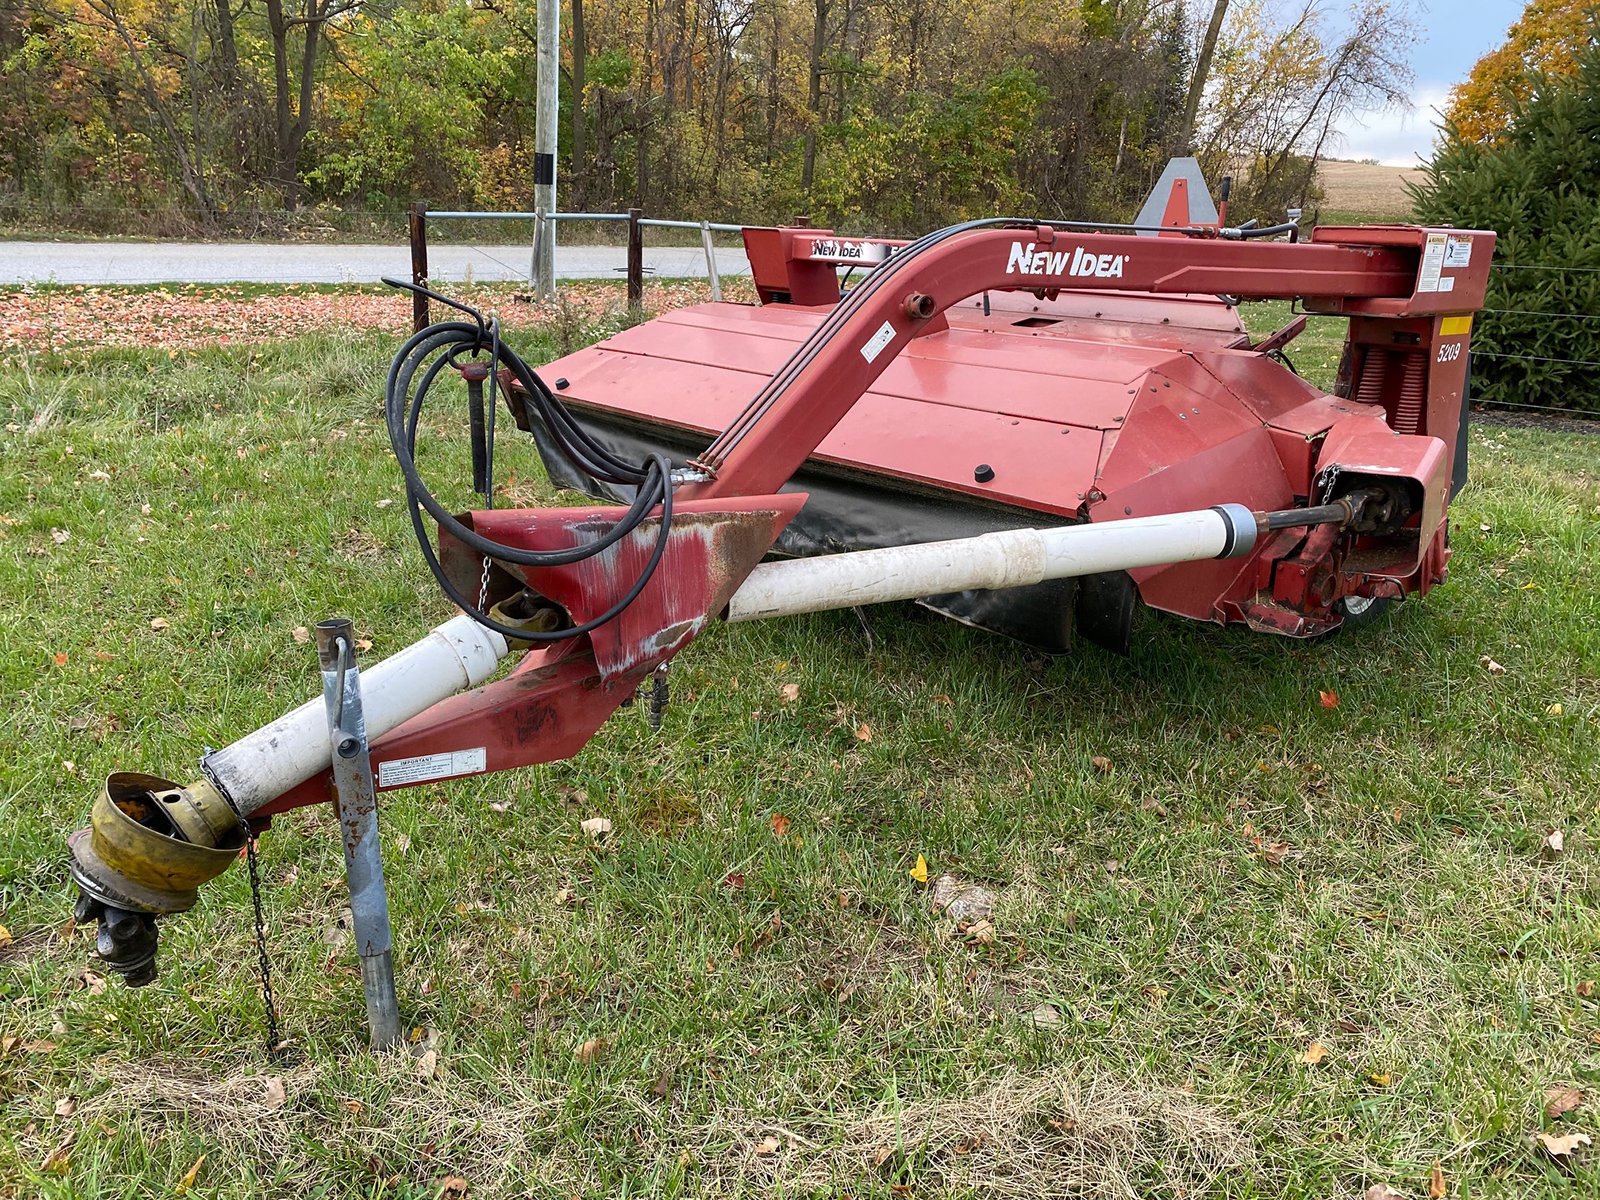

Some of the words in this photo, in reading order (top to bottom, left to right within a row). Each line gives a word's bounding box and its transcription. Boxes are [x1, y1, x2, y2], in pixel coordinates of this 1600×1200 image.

[814, 242, 837, 256] NEW
[838, 247, 860, 258] IDEA
[1006, 241, 1070, 275] NEW
[1069, 245, 1123, 278] IDEA
[1437, 342, 1461, 363] 5209
[400, 757, 433, 766] IMPORTANT
